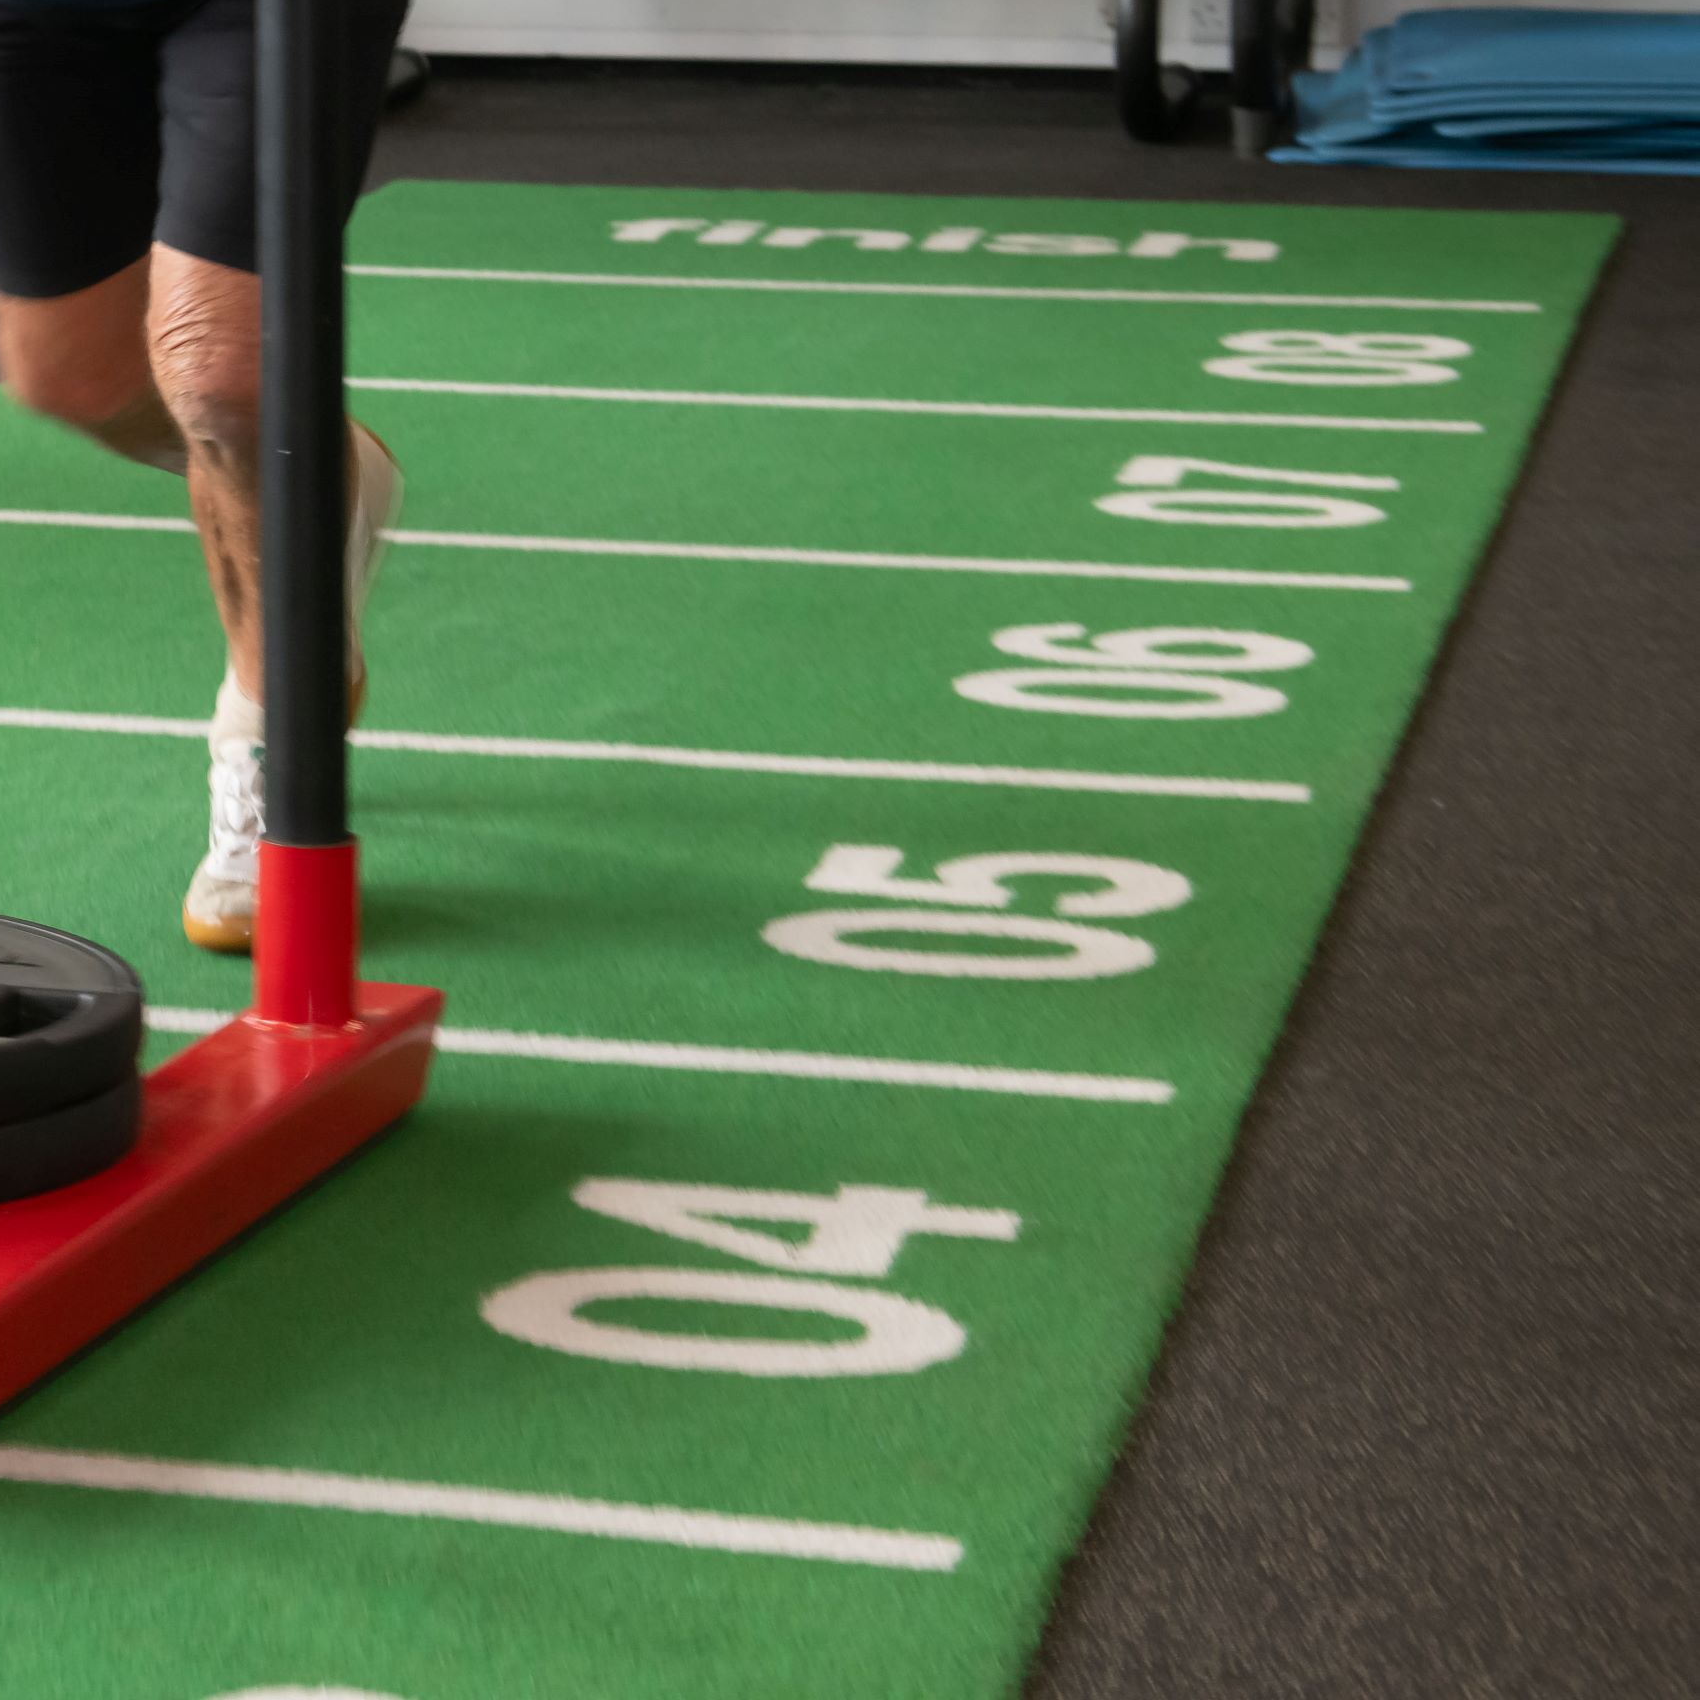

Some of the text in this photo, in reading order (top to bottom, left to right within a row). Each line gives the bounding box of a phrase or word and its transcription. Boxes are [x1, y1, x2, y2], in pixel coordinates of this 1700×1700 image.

[610, 217, 1283, 262] finish
[1202, 329, 1473, 386] 08
[1092, 455, 1400, 528] 07
[951, 621, 1315, 719] 06
[760, 843, 1193, 980] 05
[478, 1177, 1022, 1377] 04
